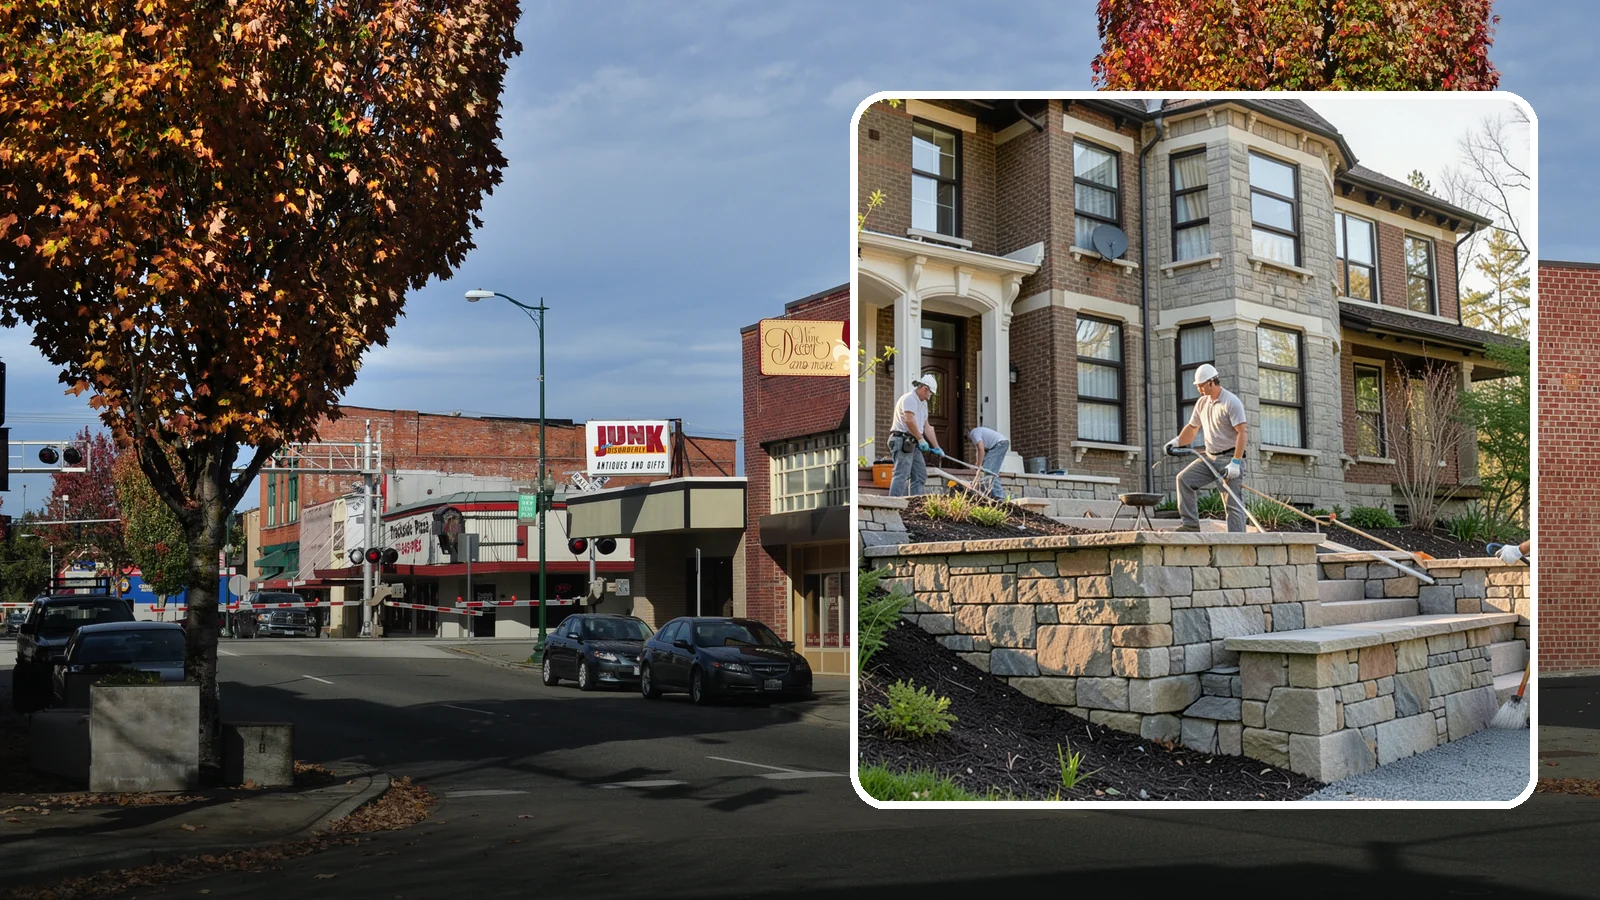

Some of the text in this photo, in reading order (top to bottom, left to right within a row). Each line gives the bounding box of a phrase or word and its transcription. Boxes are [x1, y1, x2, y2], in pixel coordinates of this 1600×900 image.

[595, 425, 665, 457] JUNK
[607, 446, 646, 454] DISORDERLY
[596, 460, 665, 470] ANTIQUES AND GIFTS
[573, 473, 588, 491] RAIL
[390, 520, 429, 540] Trackside Pizza
